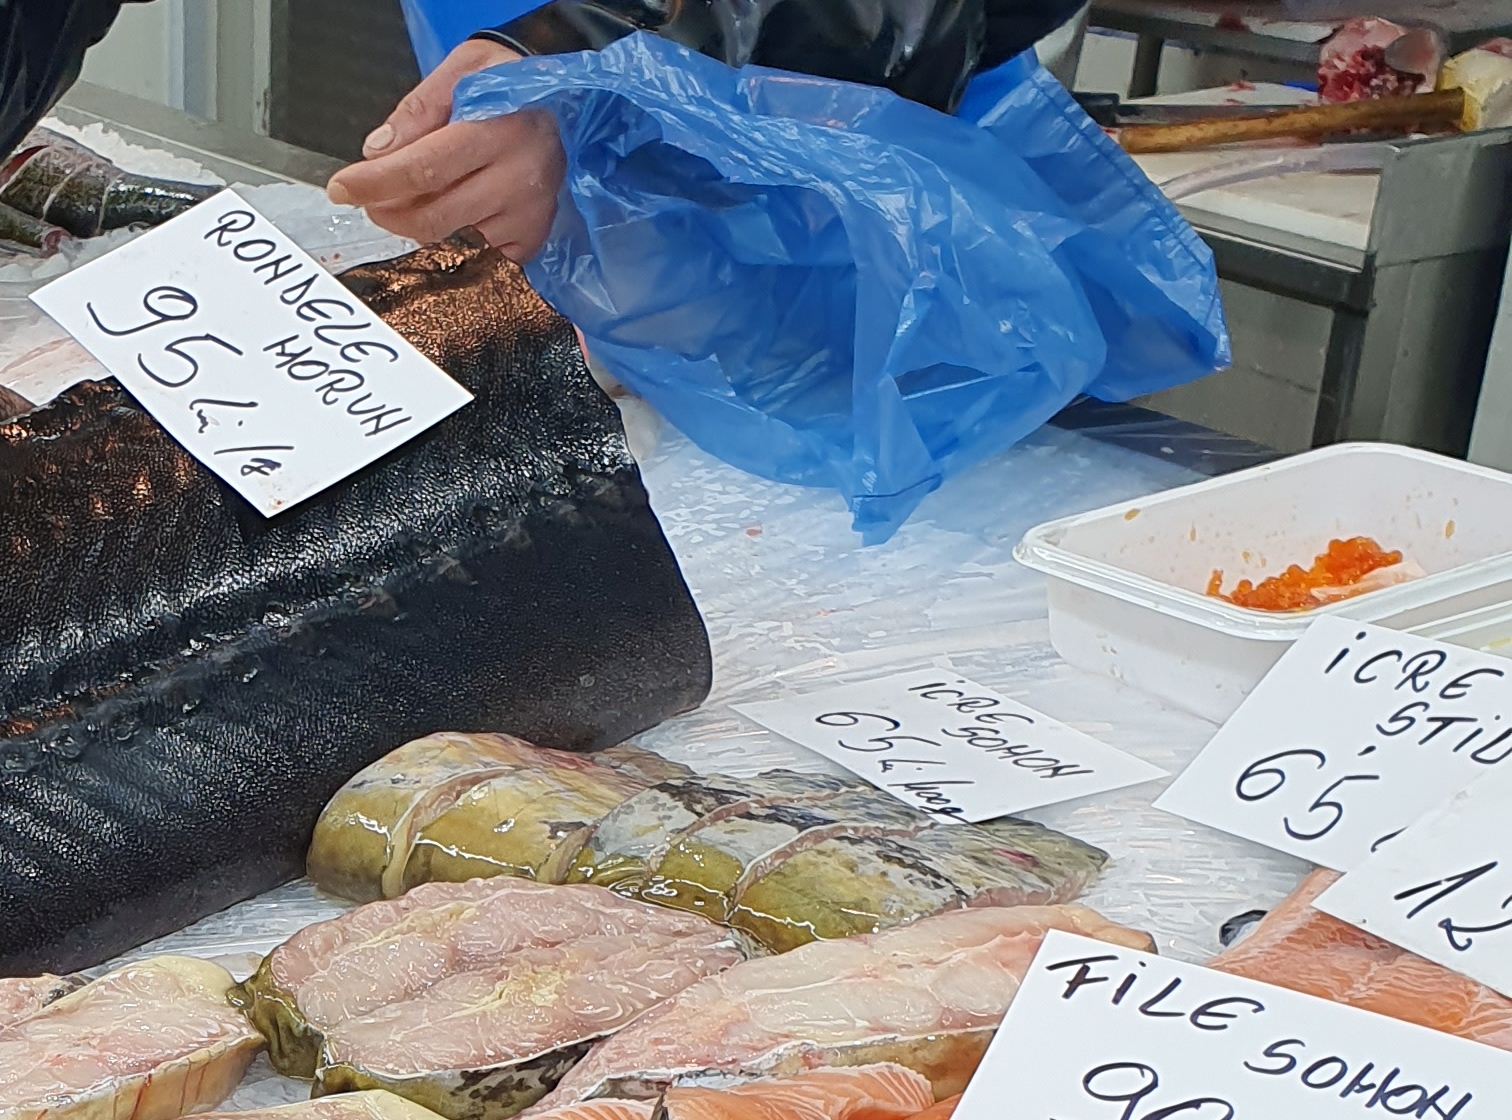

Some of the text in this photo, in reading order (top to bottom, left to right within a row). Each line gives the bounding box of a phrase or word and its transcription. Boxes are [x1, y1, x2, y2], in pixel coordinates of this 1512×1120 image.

[204, 210, 398, 365] RONDELE
[88, 286, 244, 387] 95
[814, 711, 942, 752] 65
[1236, 748, 1380, 841] 65
